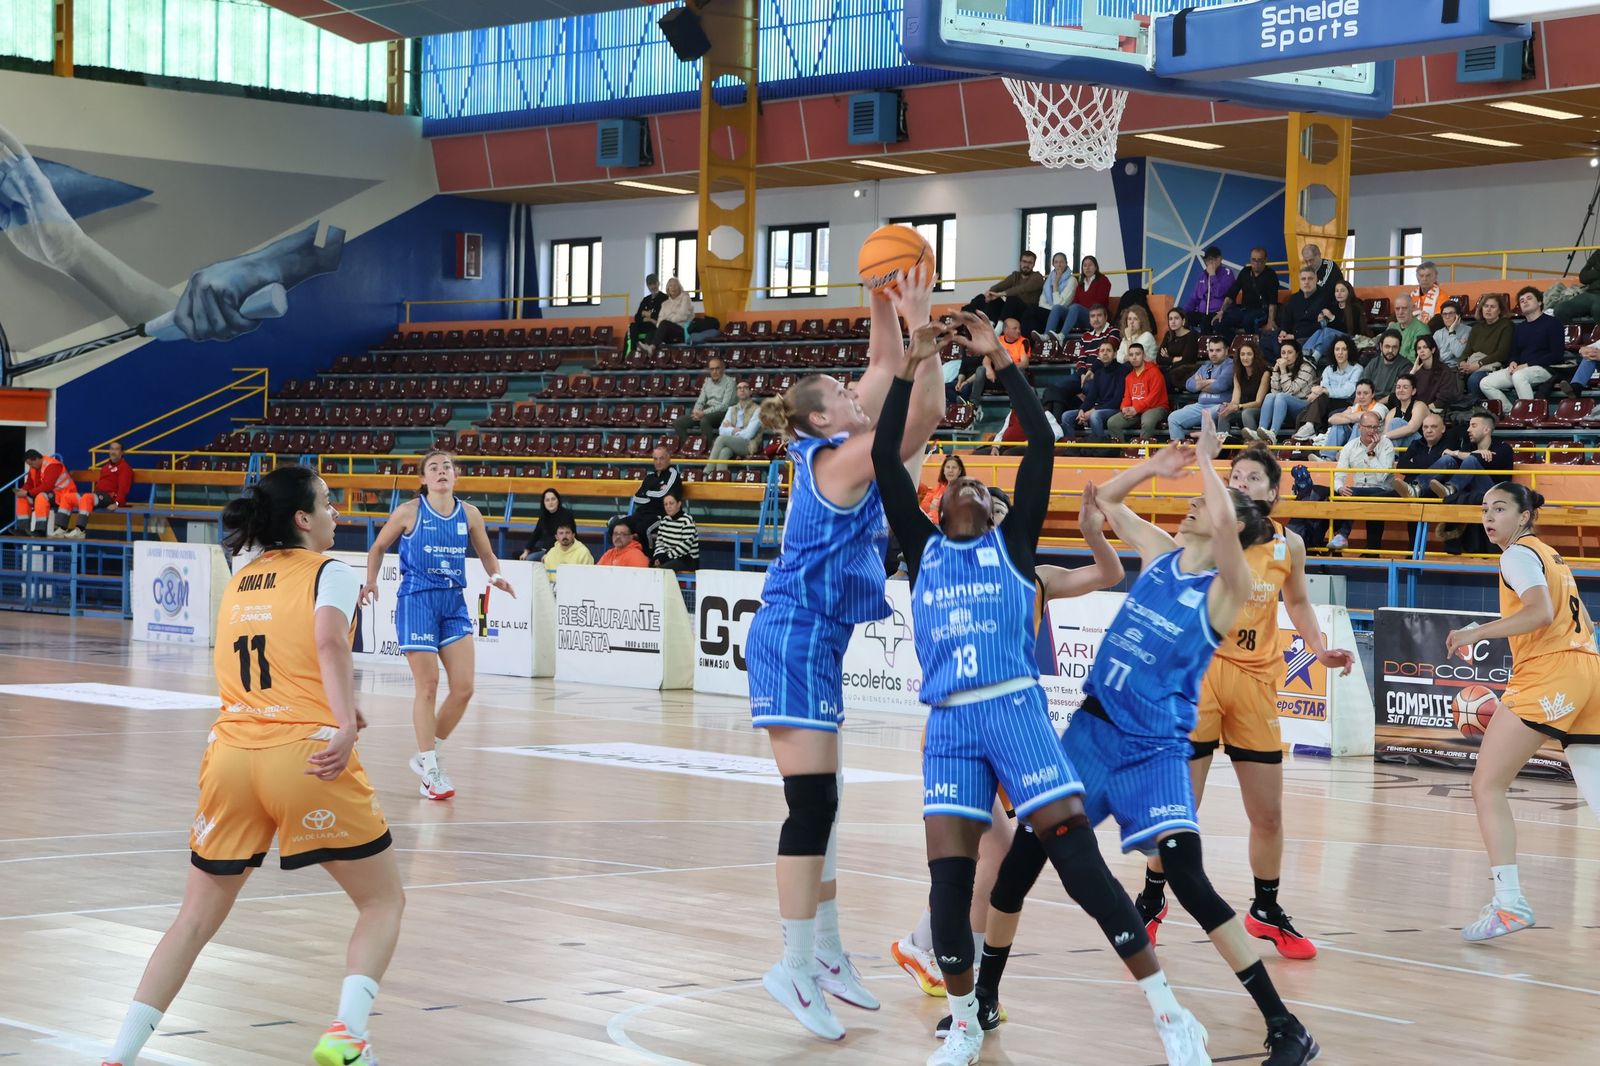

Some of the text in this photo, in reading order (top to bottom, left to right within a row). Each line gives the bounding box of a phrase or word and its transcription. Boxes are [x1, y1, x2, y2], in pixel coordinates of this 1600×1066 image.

[1261, 0, 1360, 27] Schelde
[1261, 20, 1358, 51] Sports
[237, 572, 277, 593] AINA M.
[382, 566, 397, 581] LUIS
[153, 578, 190, 607] C&M
[501, 620, 511, 629] LA
[513, 621, 528, 630] LUZ
[558, 599, 661, 632] RESTAURANTE
[558, 629, 612, 653] MARTA
[1236, 629, 1256, 651] 28
[233, 634, 272, 692] 11
[699, 657, 730, 670] GIMNASIO
[953, 643, 979, 680] 13
[1386, 690, 1453, 718] COMPITE
[1409, 714, 1453, 728] MIEDOS
[1386, 745, 1417, 754] TENEMOS
[1419, 747, 1433, 755] LOS
[1434, 749, 1467, 759] MEJORES
